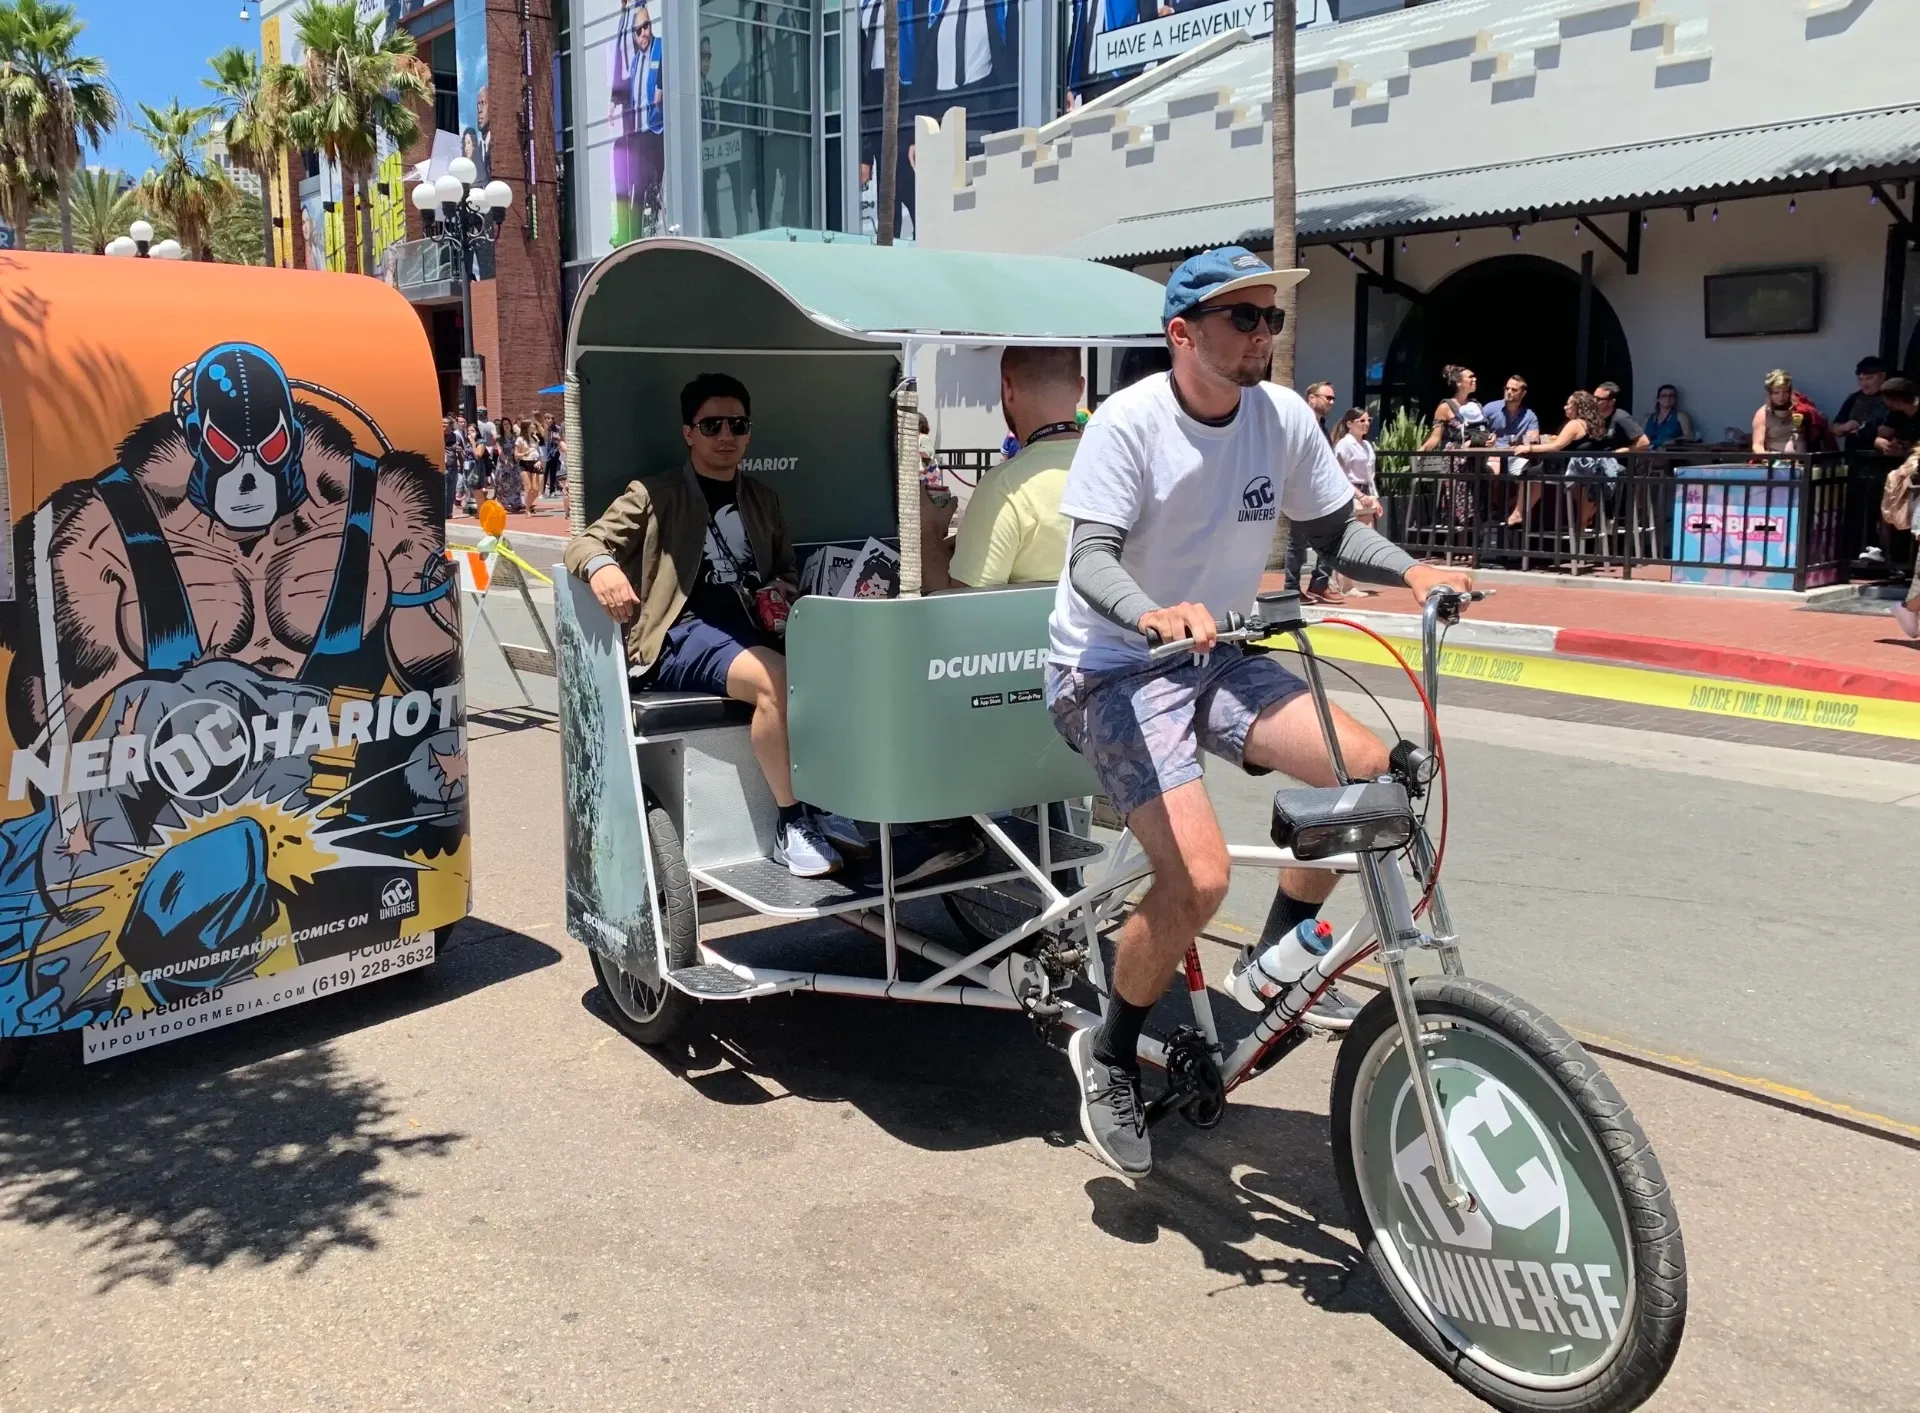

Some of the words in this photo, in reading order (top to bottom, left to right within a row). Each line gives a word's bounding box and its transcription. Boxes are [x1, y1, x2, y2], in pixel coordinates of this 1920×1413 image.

[1107, 33, 1147, 61] HAVE
[1152, 30, 1164, 49] A
[1169, 4, 1257, 45] HEAVENLY
[1243, 480, 1275, 509] DC
[380, 901, 416, 920] UNIVERSE
[382, 878, 412, 908] DC
[106, 974, 138, 993] SEE
[140, 935, 288, 984] GROUNDBREAKING
[291, 918, 346, 943] COMICS
[347, 913, 369, 929] ON
[88, 985, 305, 1054] VIPOUTDOORMEDIA.COM
[312, 968, 356, 996] (619)
[361, 946, 434, 979] 228-3632
